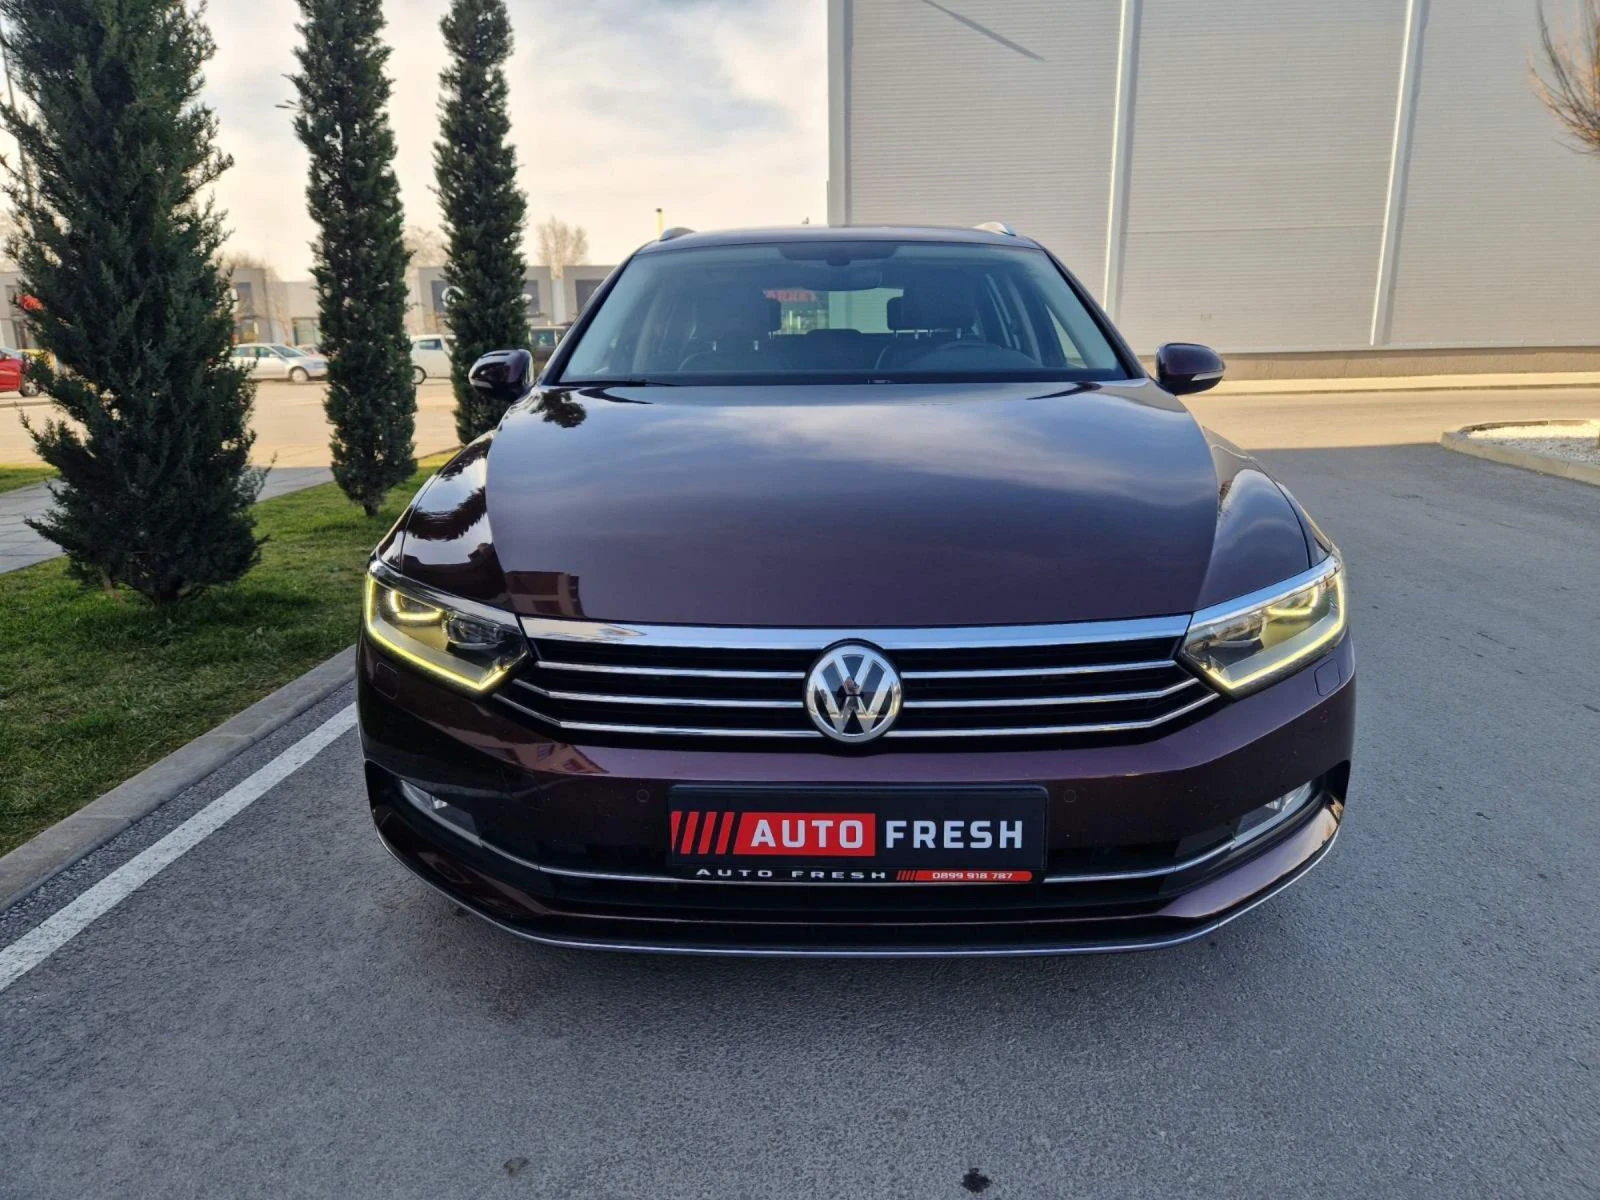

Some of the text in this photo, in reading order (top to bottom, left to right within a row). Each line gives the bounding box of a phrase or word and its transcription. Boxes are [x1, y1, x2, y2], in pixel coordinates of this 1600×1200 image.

[750, 819, 1023, 849] AUTO FRESH
[696, 868, 886, 879] AUTO FRESH
[931, 871, 964, 880] 0899
[966, 871, 988, 880] 918
